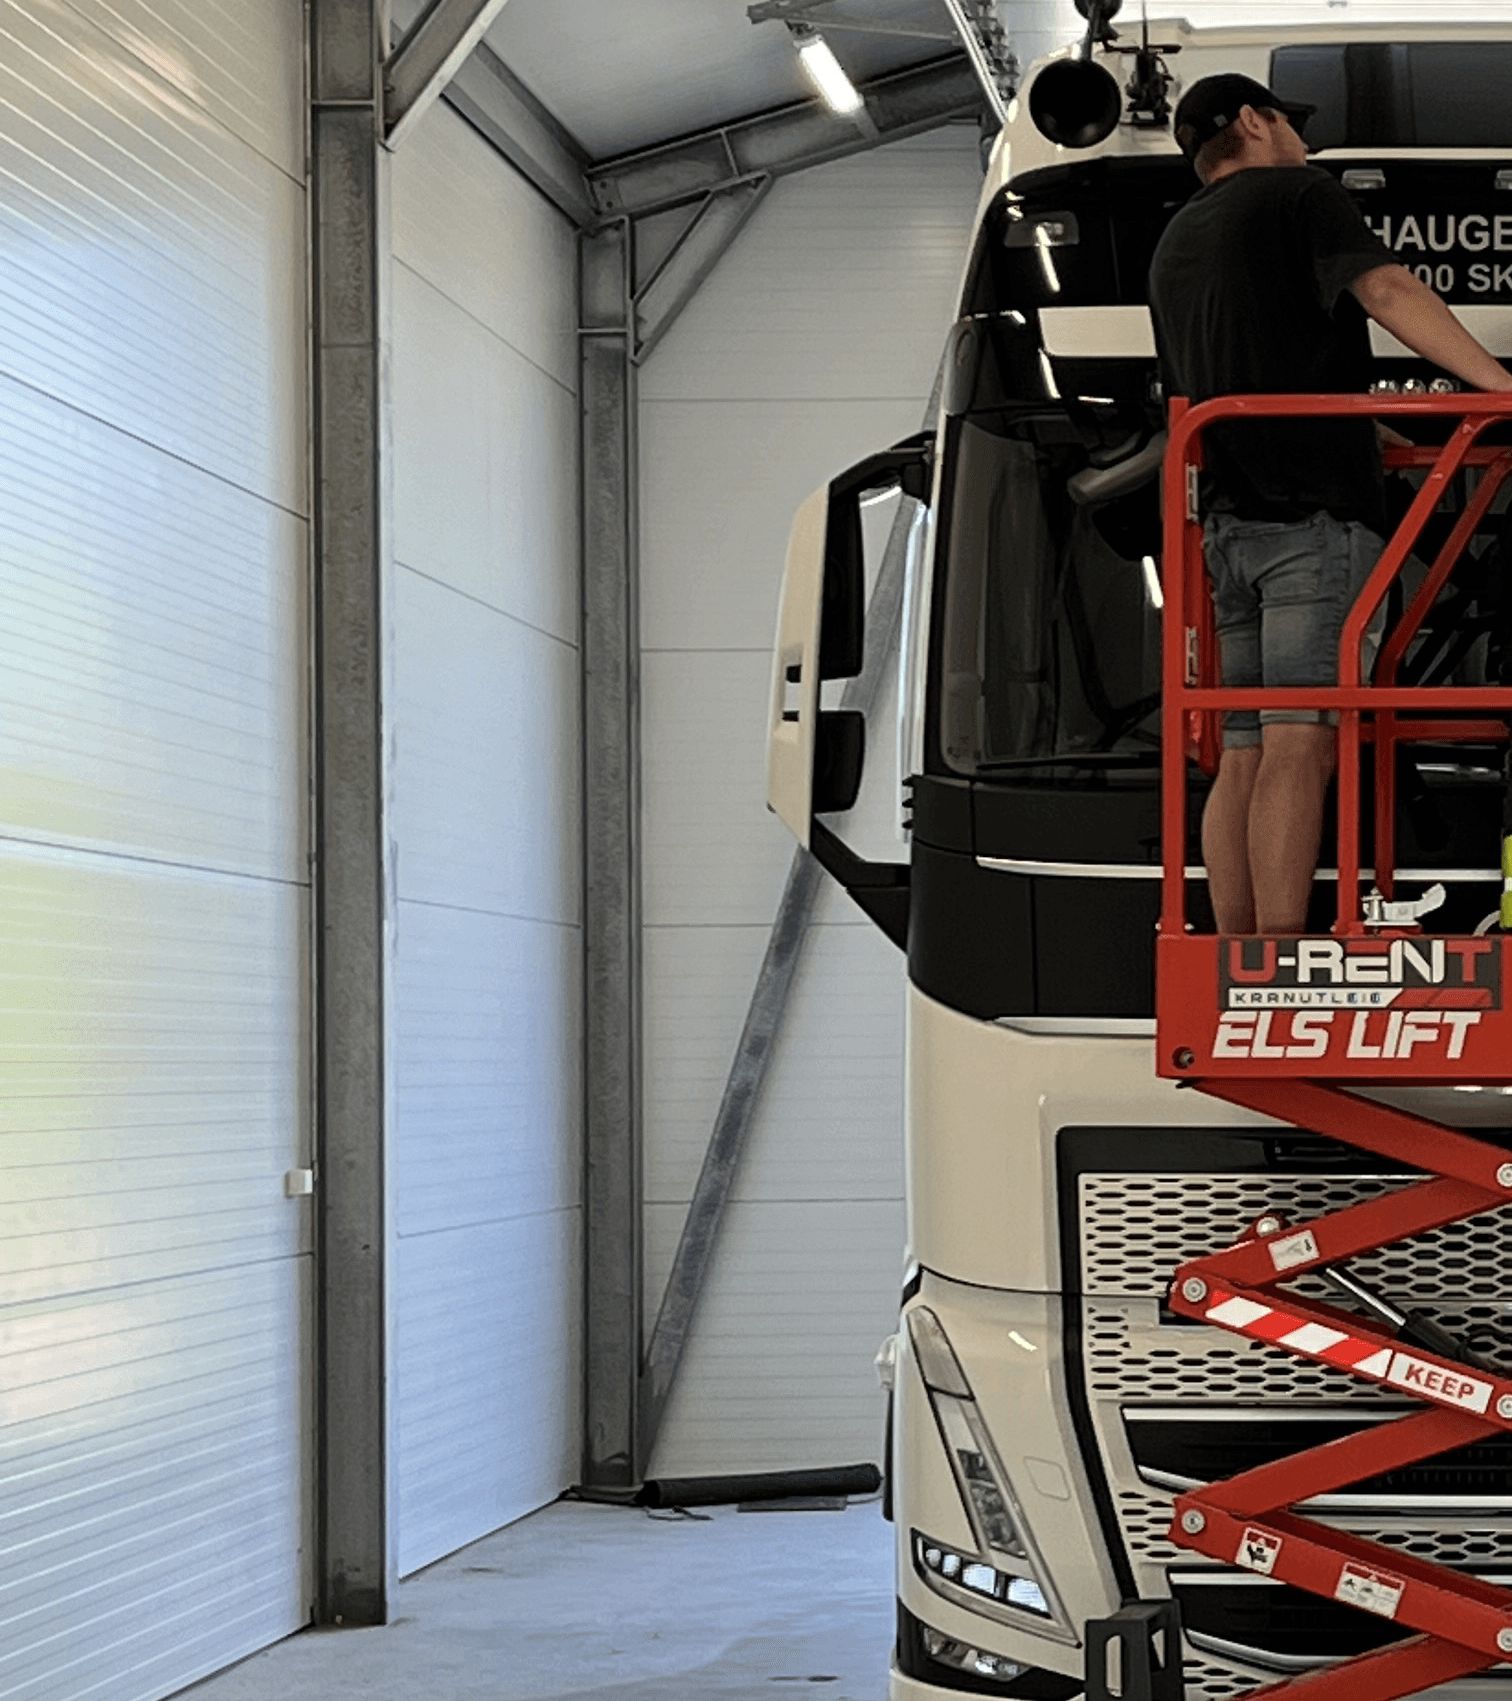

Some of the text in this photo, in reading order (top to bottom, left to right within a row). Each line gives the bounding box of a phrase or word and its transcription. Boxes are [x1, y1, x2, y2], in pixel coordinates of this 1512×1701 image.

[1402, 263, 1455, 292] 00
[1229, 939, 1493, 983] U-RENT
[1233, 991, 1381, 1005] KRANUTLEIE
[1211, 1010, 1482, 1059] ELS LIFT
[1405, 1363, 1475, 1400] KEEP
